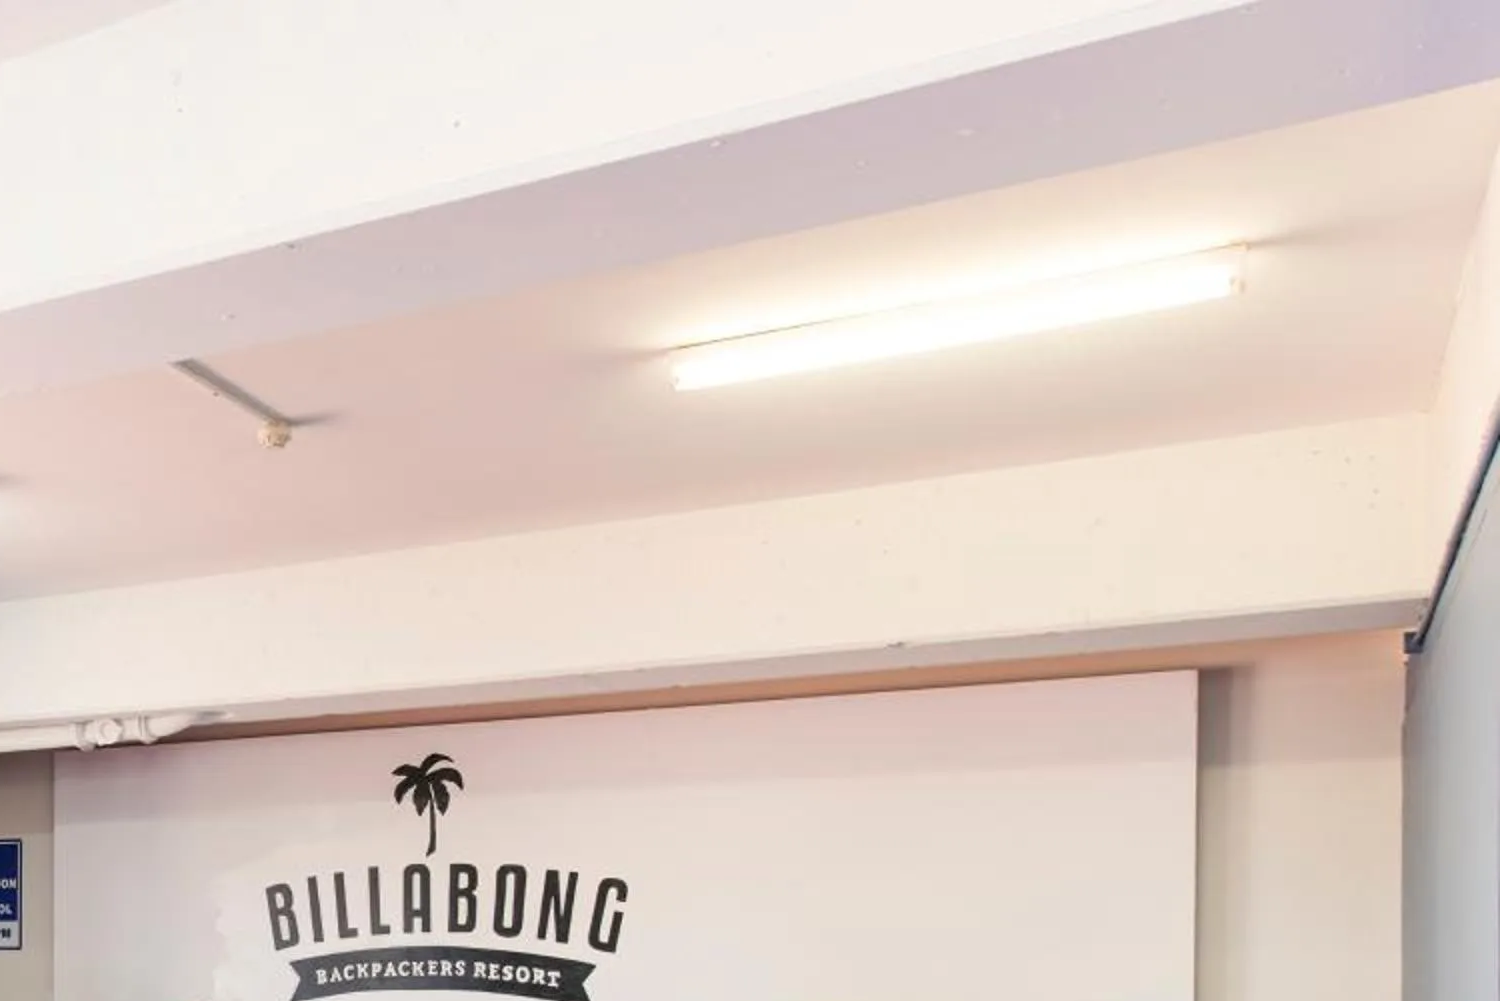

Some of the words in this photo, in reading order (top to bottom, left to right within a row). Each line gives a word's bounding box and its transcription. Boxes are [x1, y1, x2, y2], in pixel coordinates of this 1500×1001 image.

[265, 863, 629, 953] BILLABONG
[315, 959, 466, 985] BACKPACKERS
[473, 960, 562, 988] RESORT
